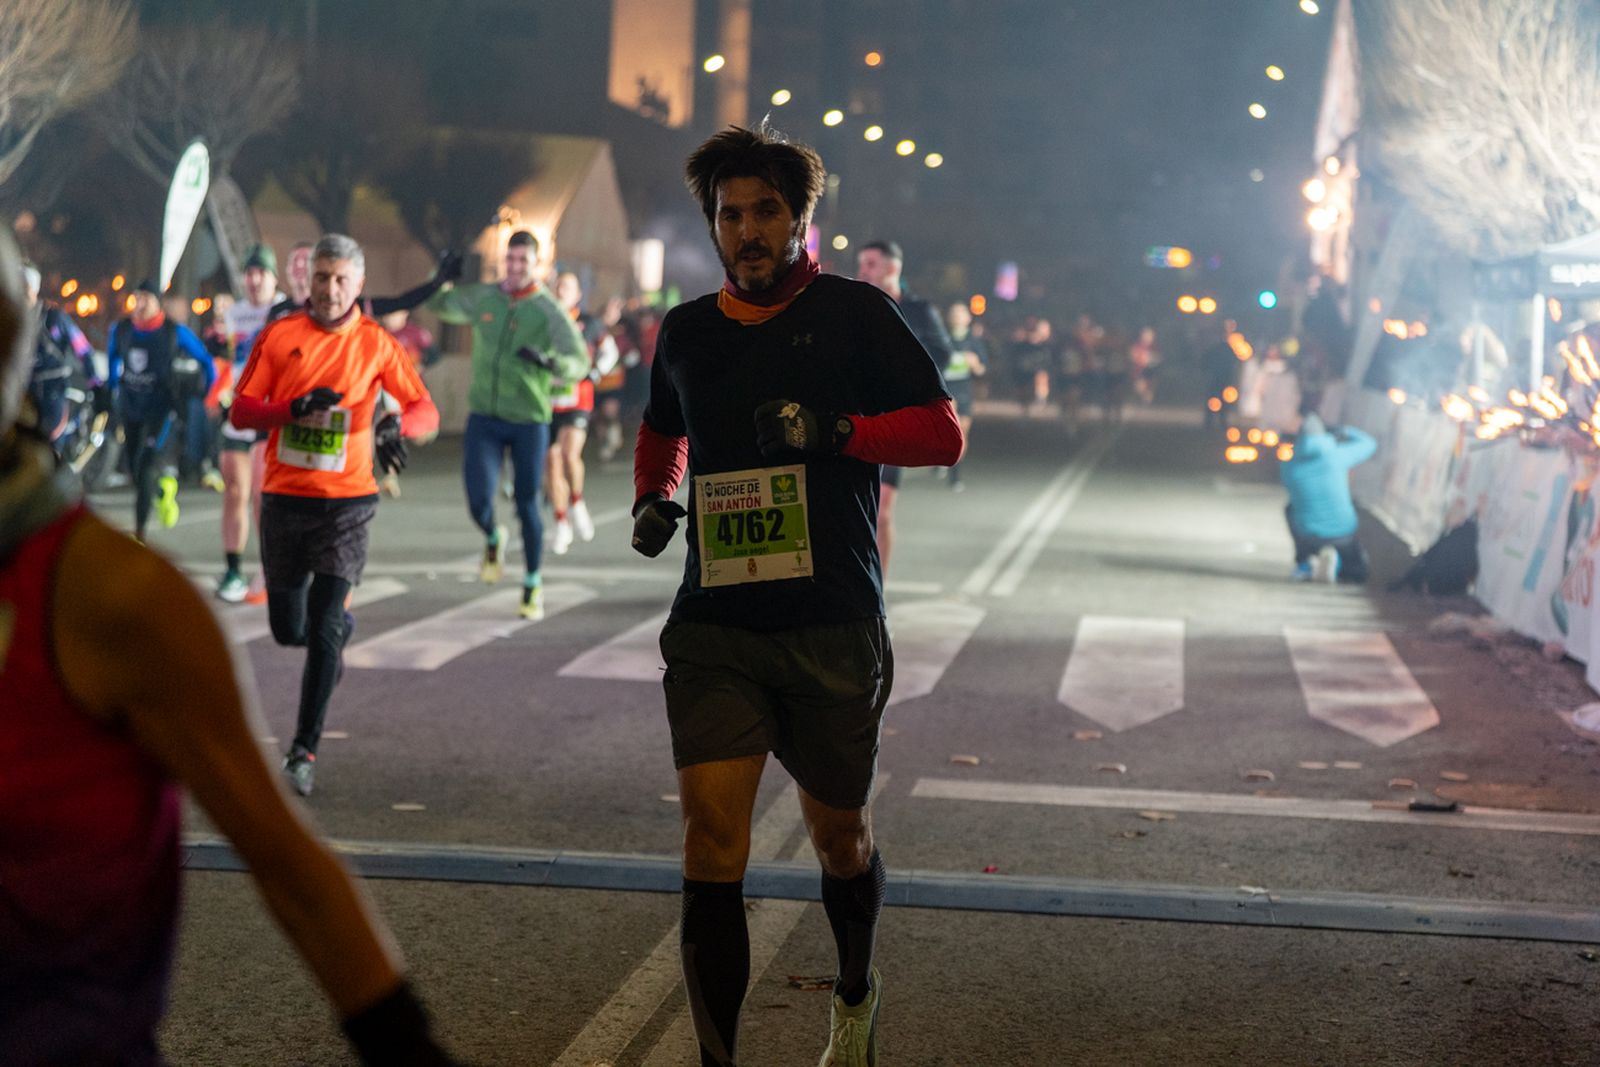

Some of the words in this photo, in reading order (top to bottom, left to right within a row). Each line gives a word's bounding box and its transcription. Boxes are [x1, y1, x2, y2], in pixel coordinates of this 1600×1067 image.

[714, 484, 745, 497] NOCHE
[747, 482, 760, 494] DE
[707, 500, 724, 512] SAN
[725, 494, 761, 511] ANTÓN
[717, 508, 786, 546] 4762
